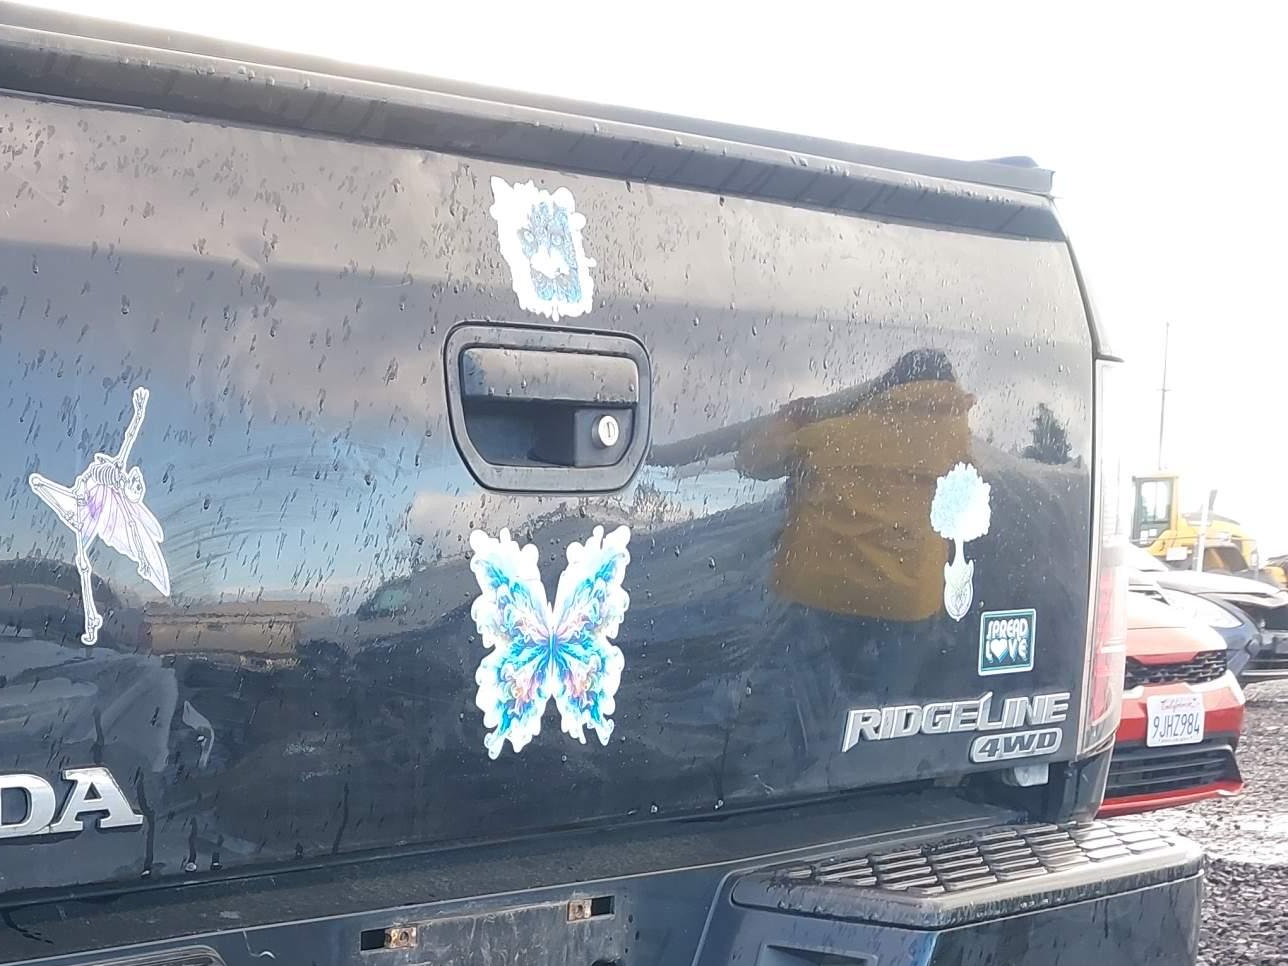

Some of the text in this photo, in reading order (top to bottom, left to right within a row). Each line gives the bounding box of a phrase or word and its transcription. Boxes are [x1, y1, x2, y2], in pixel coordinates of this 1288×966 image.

[985, 618, 1029, 641] SPREAD
[841, 691, 1071, 752] RIDGELINE
[1152, 712, 1200, 739] 9JHZ984
[978, 732, 1059, 757] 4WD
